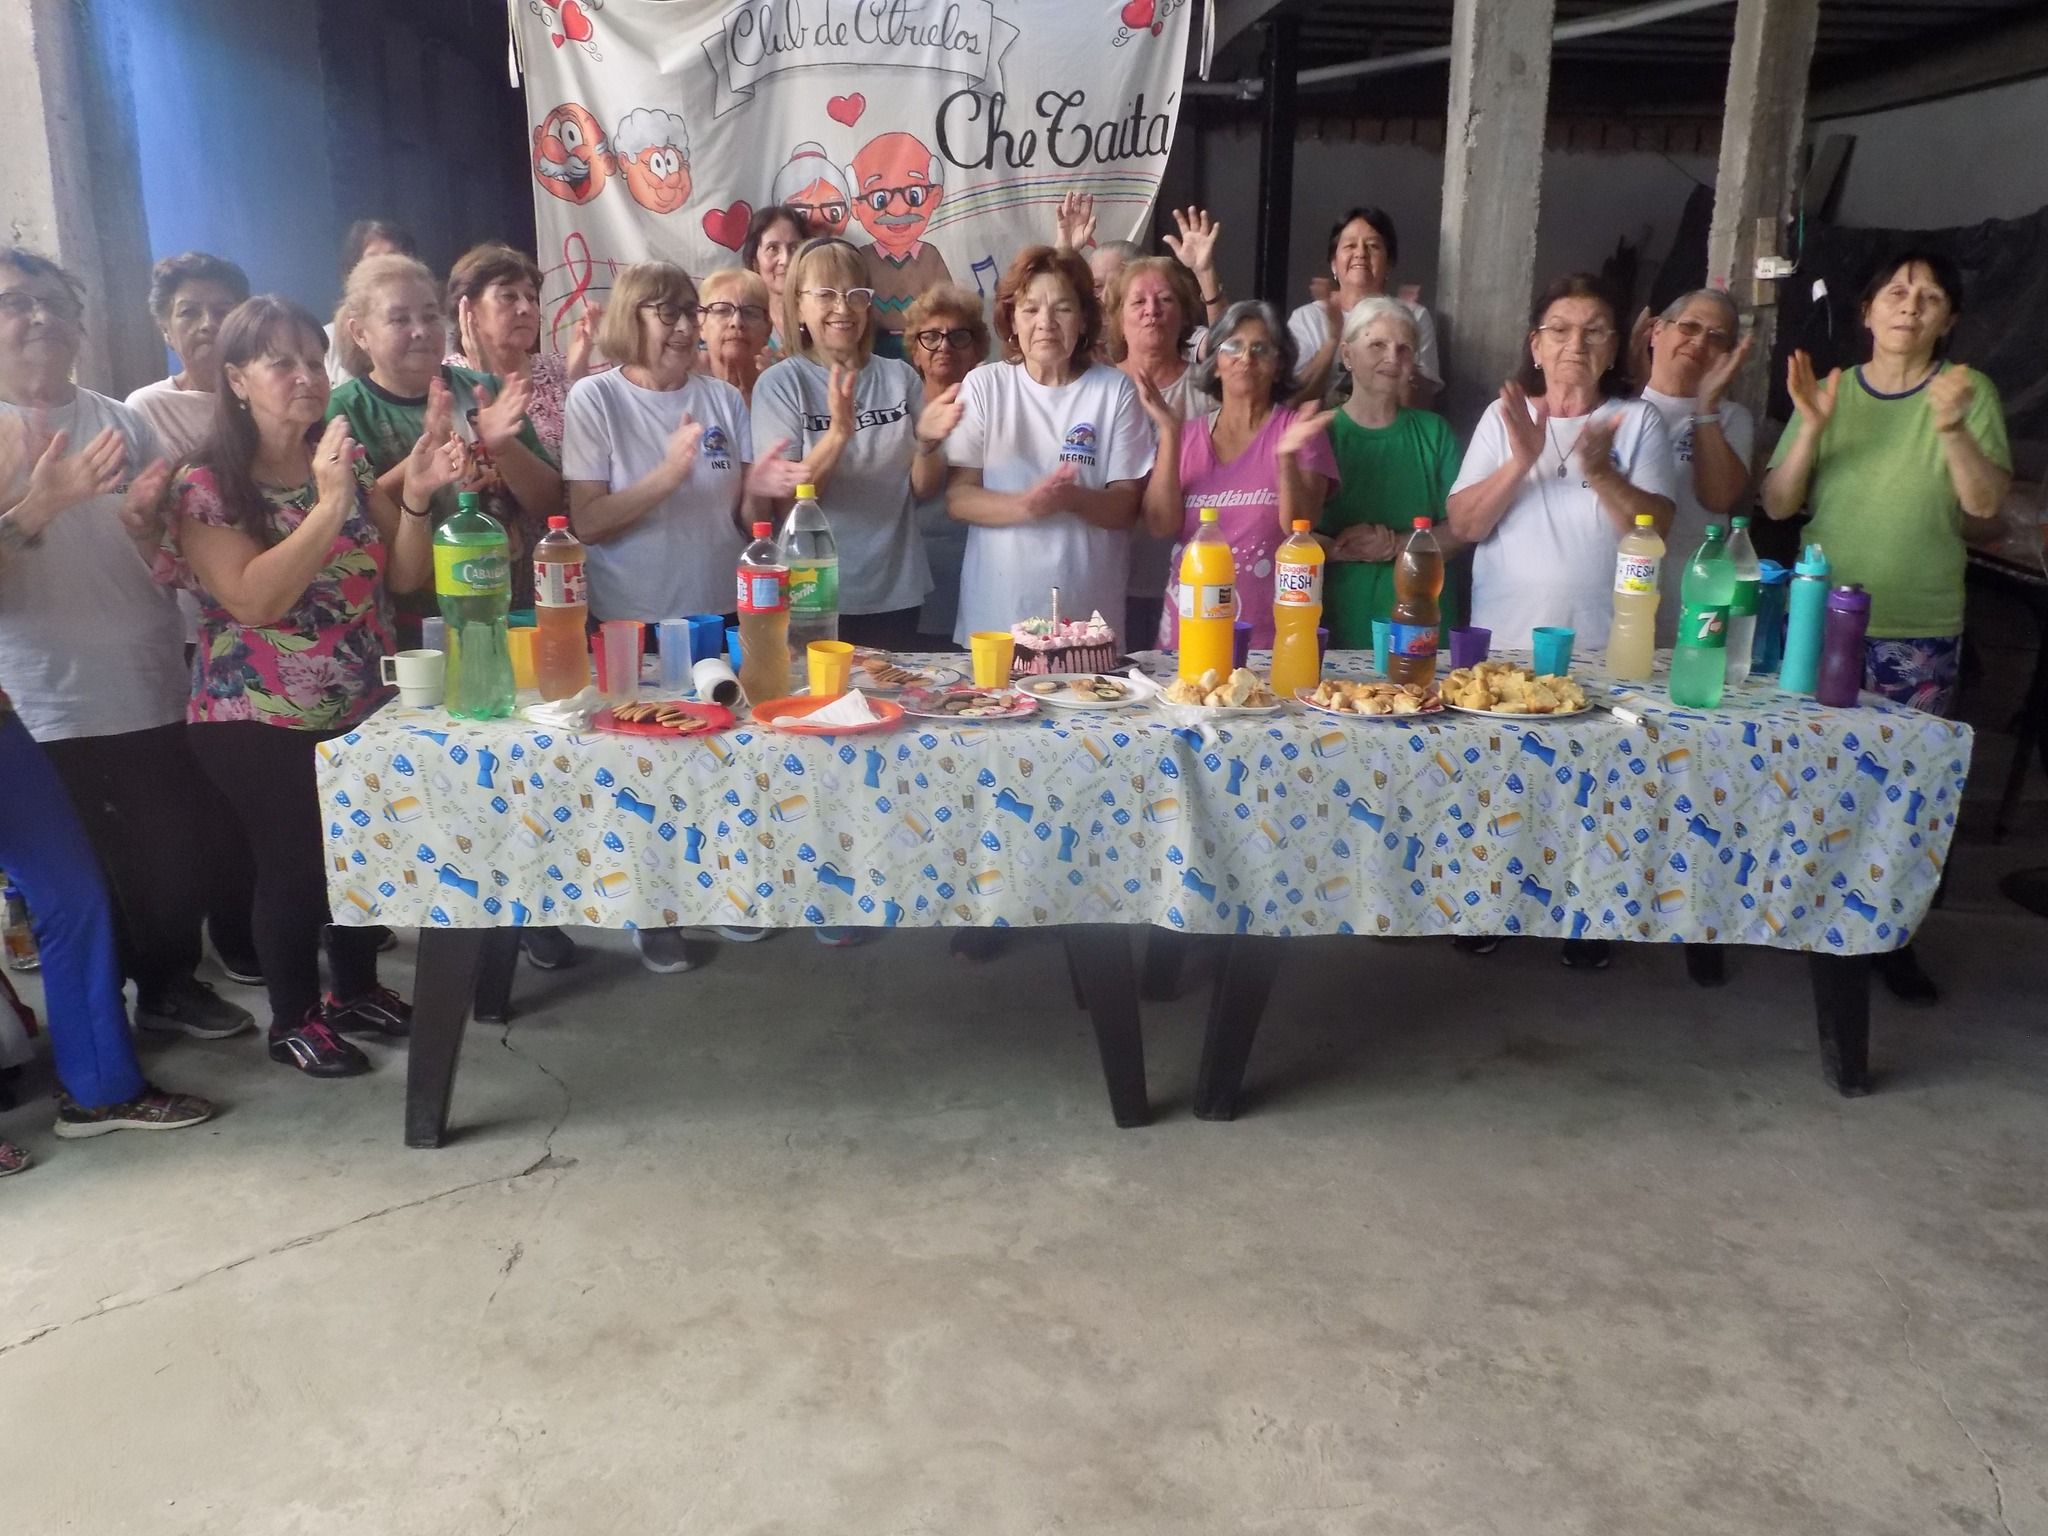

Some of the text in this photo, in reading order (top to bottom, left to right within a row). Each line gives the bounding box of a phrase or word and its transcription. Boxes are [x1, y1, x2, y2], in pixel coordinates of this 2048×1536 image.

[731, 0, 809, 66] Club
[814, 0, 849, 46] de
[936, 89, 1176, 170] Che Taitá
[1059, 453, 1096, 467] NEGRITA
[1184, 487, 1279, 508] nsatlántic
[1625, 564, 1656, 578] FRESH
[1279, 573, 1313, 590] FRESH
